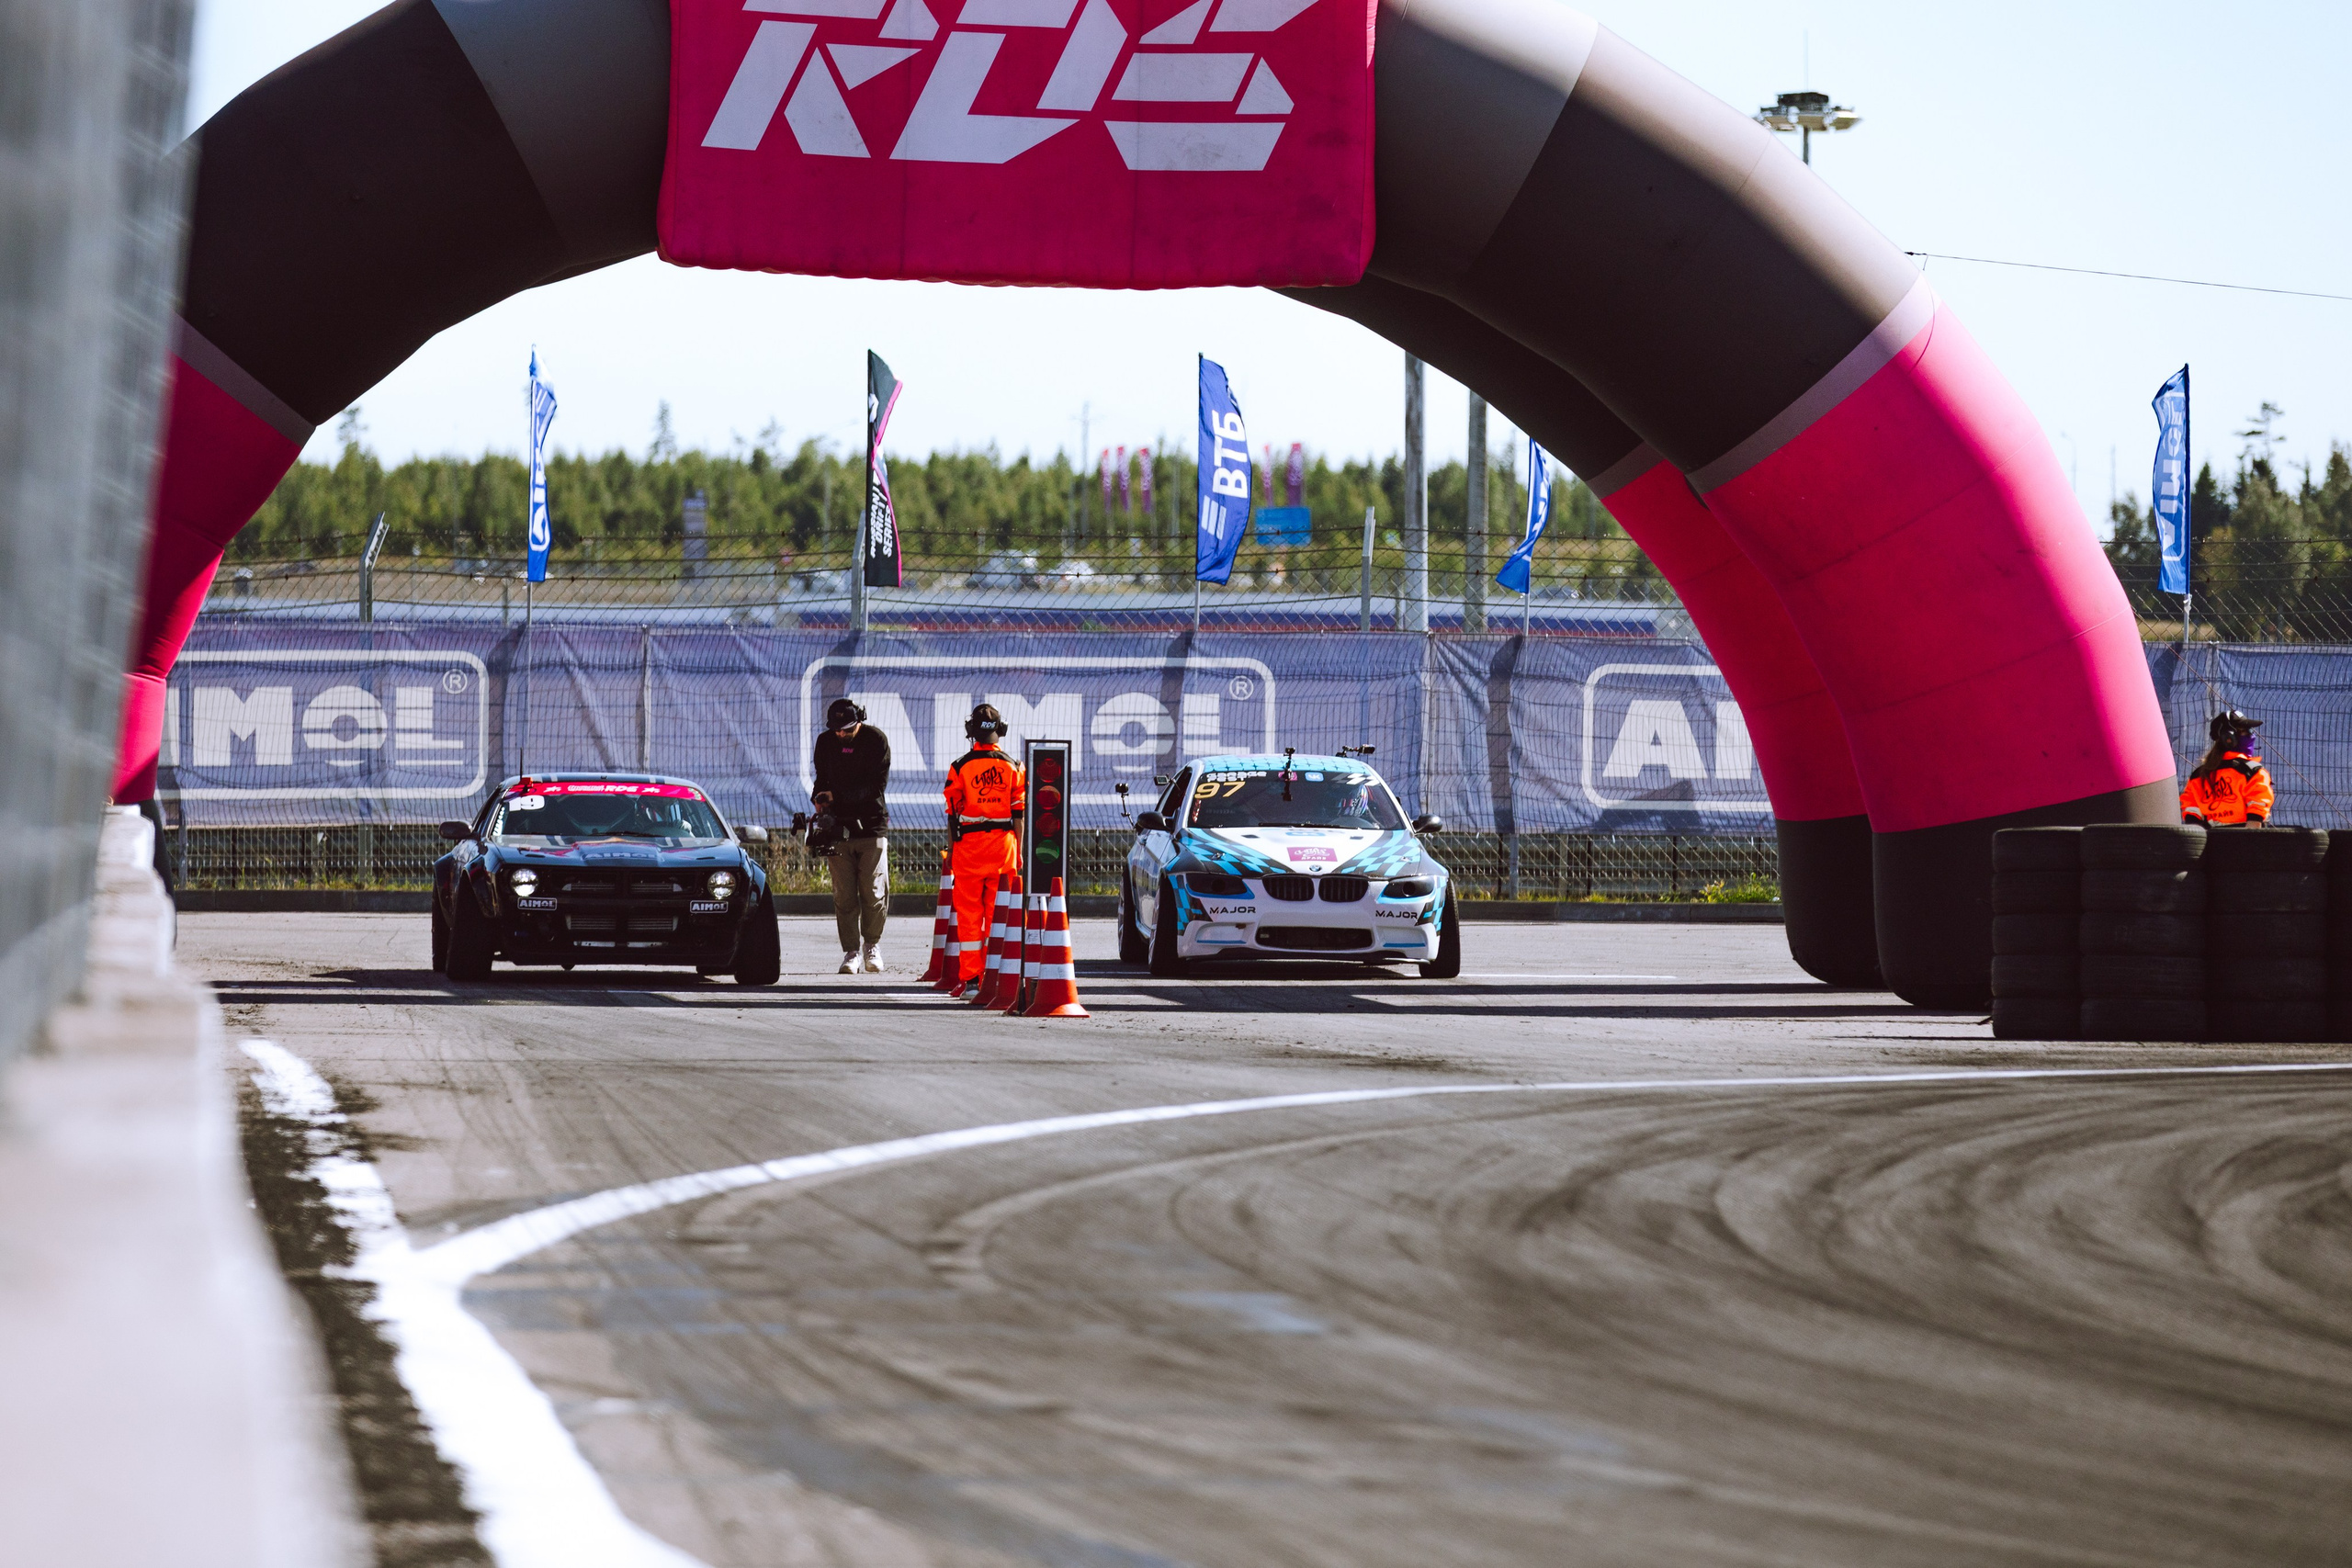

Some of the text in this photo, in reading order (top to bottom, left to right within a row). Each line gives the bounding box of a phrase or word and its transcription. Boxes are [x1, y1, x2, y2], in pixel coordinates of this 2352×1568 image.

[701, 0, 1318, 171] RDS
[1212, 410, 1249, 499] ВТБ
[1194, 782, 1246, 798] 97
[520, 899, 555, 908] AIMOL
[693, 903, 726, 911] AIMOL
[1375, 910, 1418, 919] MAJOR
